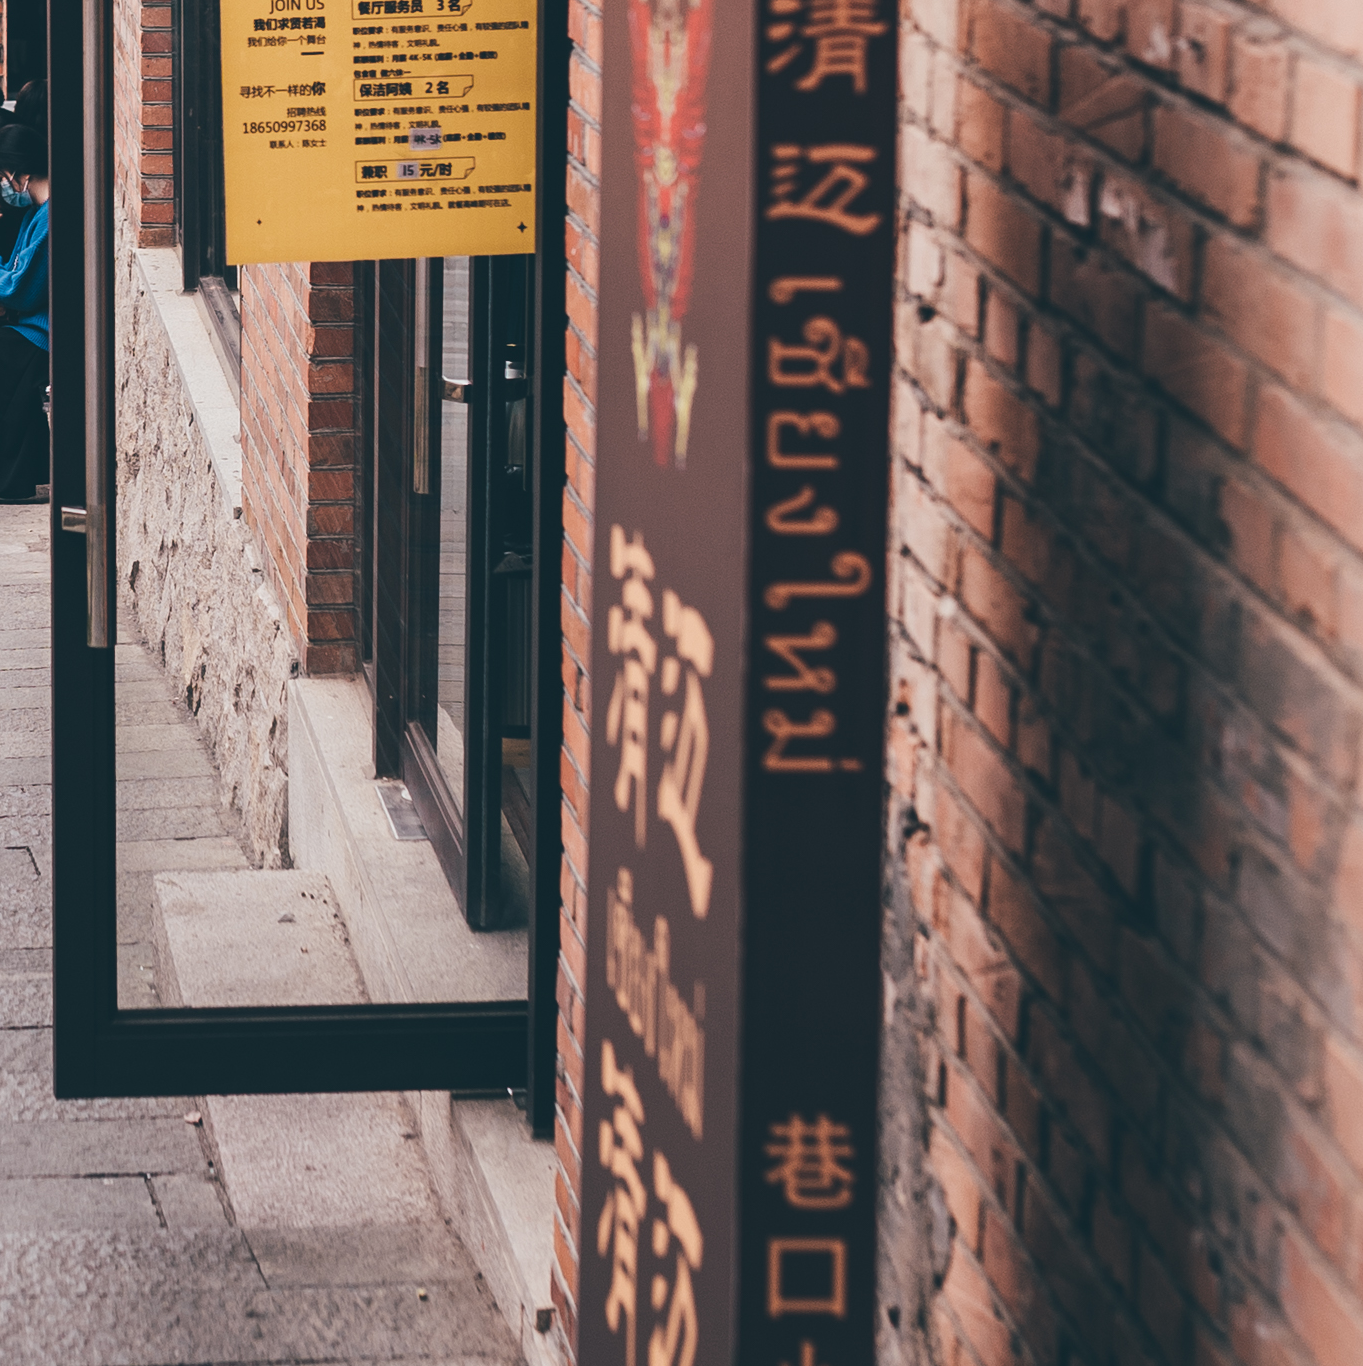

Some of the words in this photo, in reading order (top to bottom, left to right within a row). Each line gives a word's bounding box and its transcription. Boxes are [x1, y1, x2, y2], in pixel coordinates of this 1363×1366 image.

[358, 0, 423, 15] 餐厅服务员
[253, 17, 326, 31] 我们求贤若渴
[247, 35, 326, 47] 我们给你一个舞台
[239, 81, 326, 99] 寻找不一样的你
[359, 82, 412, 98] 保洁阿姨
[287, 107, 326, 118] 招聘热线
[242, 120, 327, 134] 18650997368
[361, 165, 387, 179] 兼职
